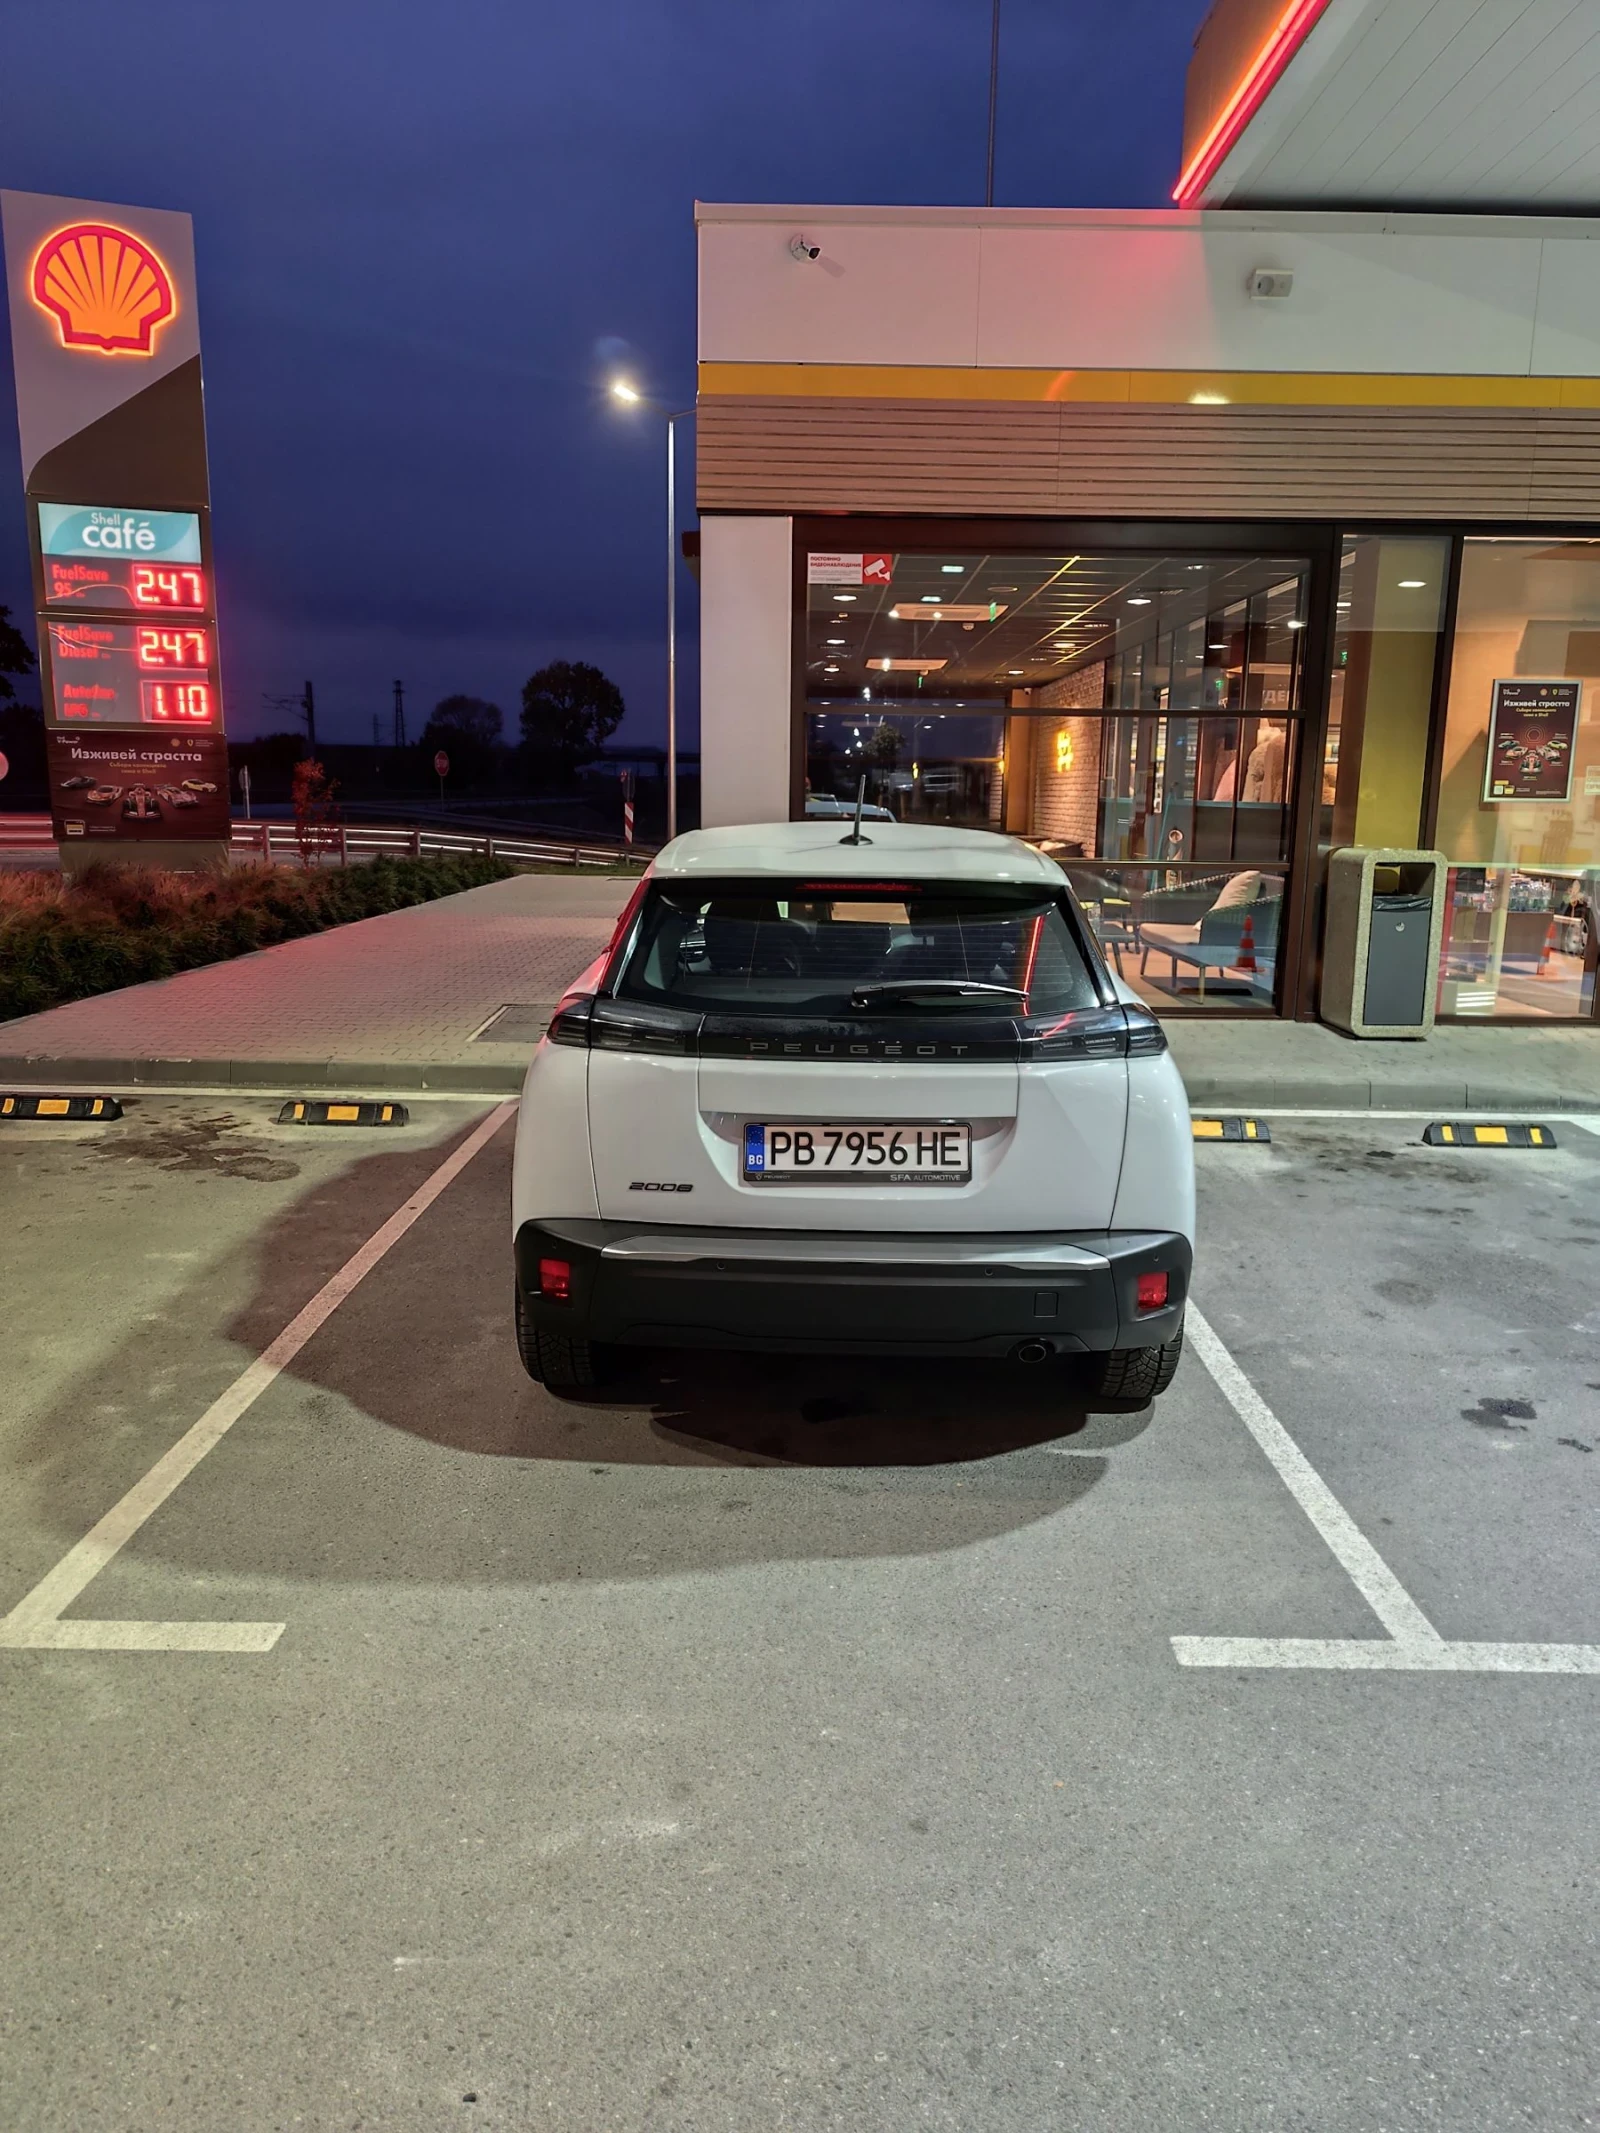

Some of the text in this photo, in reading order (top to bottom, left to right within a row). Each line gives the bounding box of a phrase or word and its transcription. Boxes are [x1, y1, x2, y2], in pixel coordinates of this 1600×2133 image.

[91, 512, 121, 525] Shell
[82, 517, 156, 550] café
[52, 564, 110, 582] FuelSave
[54, 581, 72, 598] 95
[136, 569, 202, 604] 2.47
[57, 625, 114, 642] FuelSave
[59, 643, 98, 660] Diesel
[141, 631, 206, 664] 2.47
[156, 685, 208, 716] 1.10
[1503, 699, 1537, 707] Изживей
[71, 747, 203, 763] Изживей страстта
[750, 1043, 968, 1056] PEUGEOT
[770, 1131, 962, 1166] PB 7956 HE
[748, 1154, 764, 1165] BG
[890, 1173, 961, 1182] SFA AUTOMOTIVE
[628, 1182, 694, 1193] 2008
